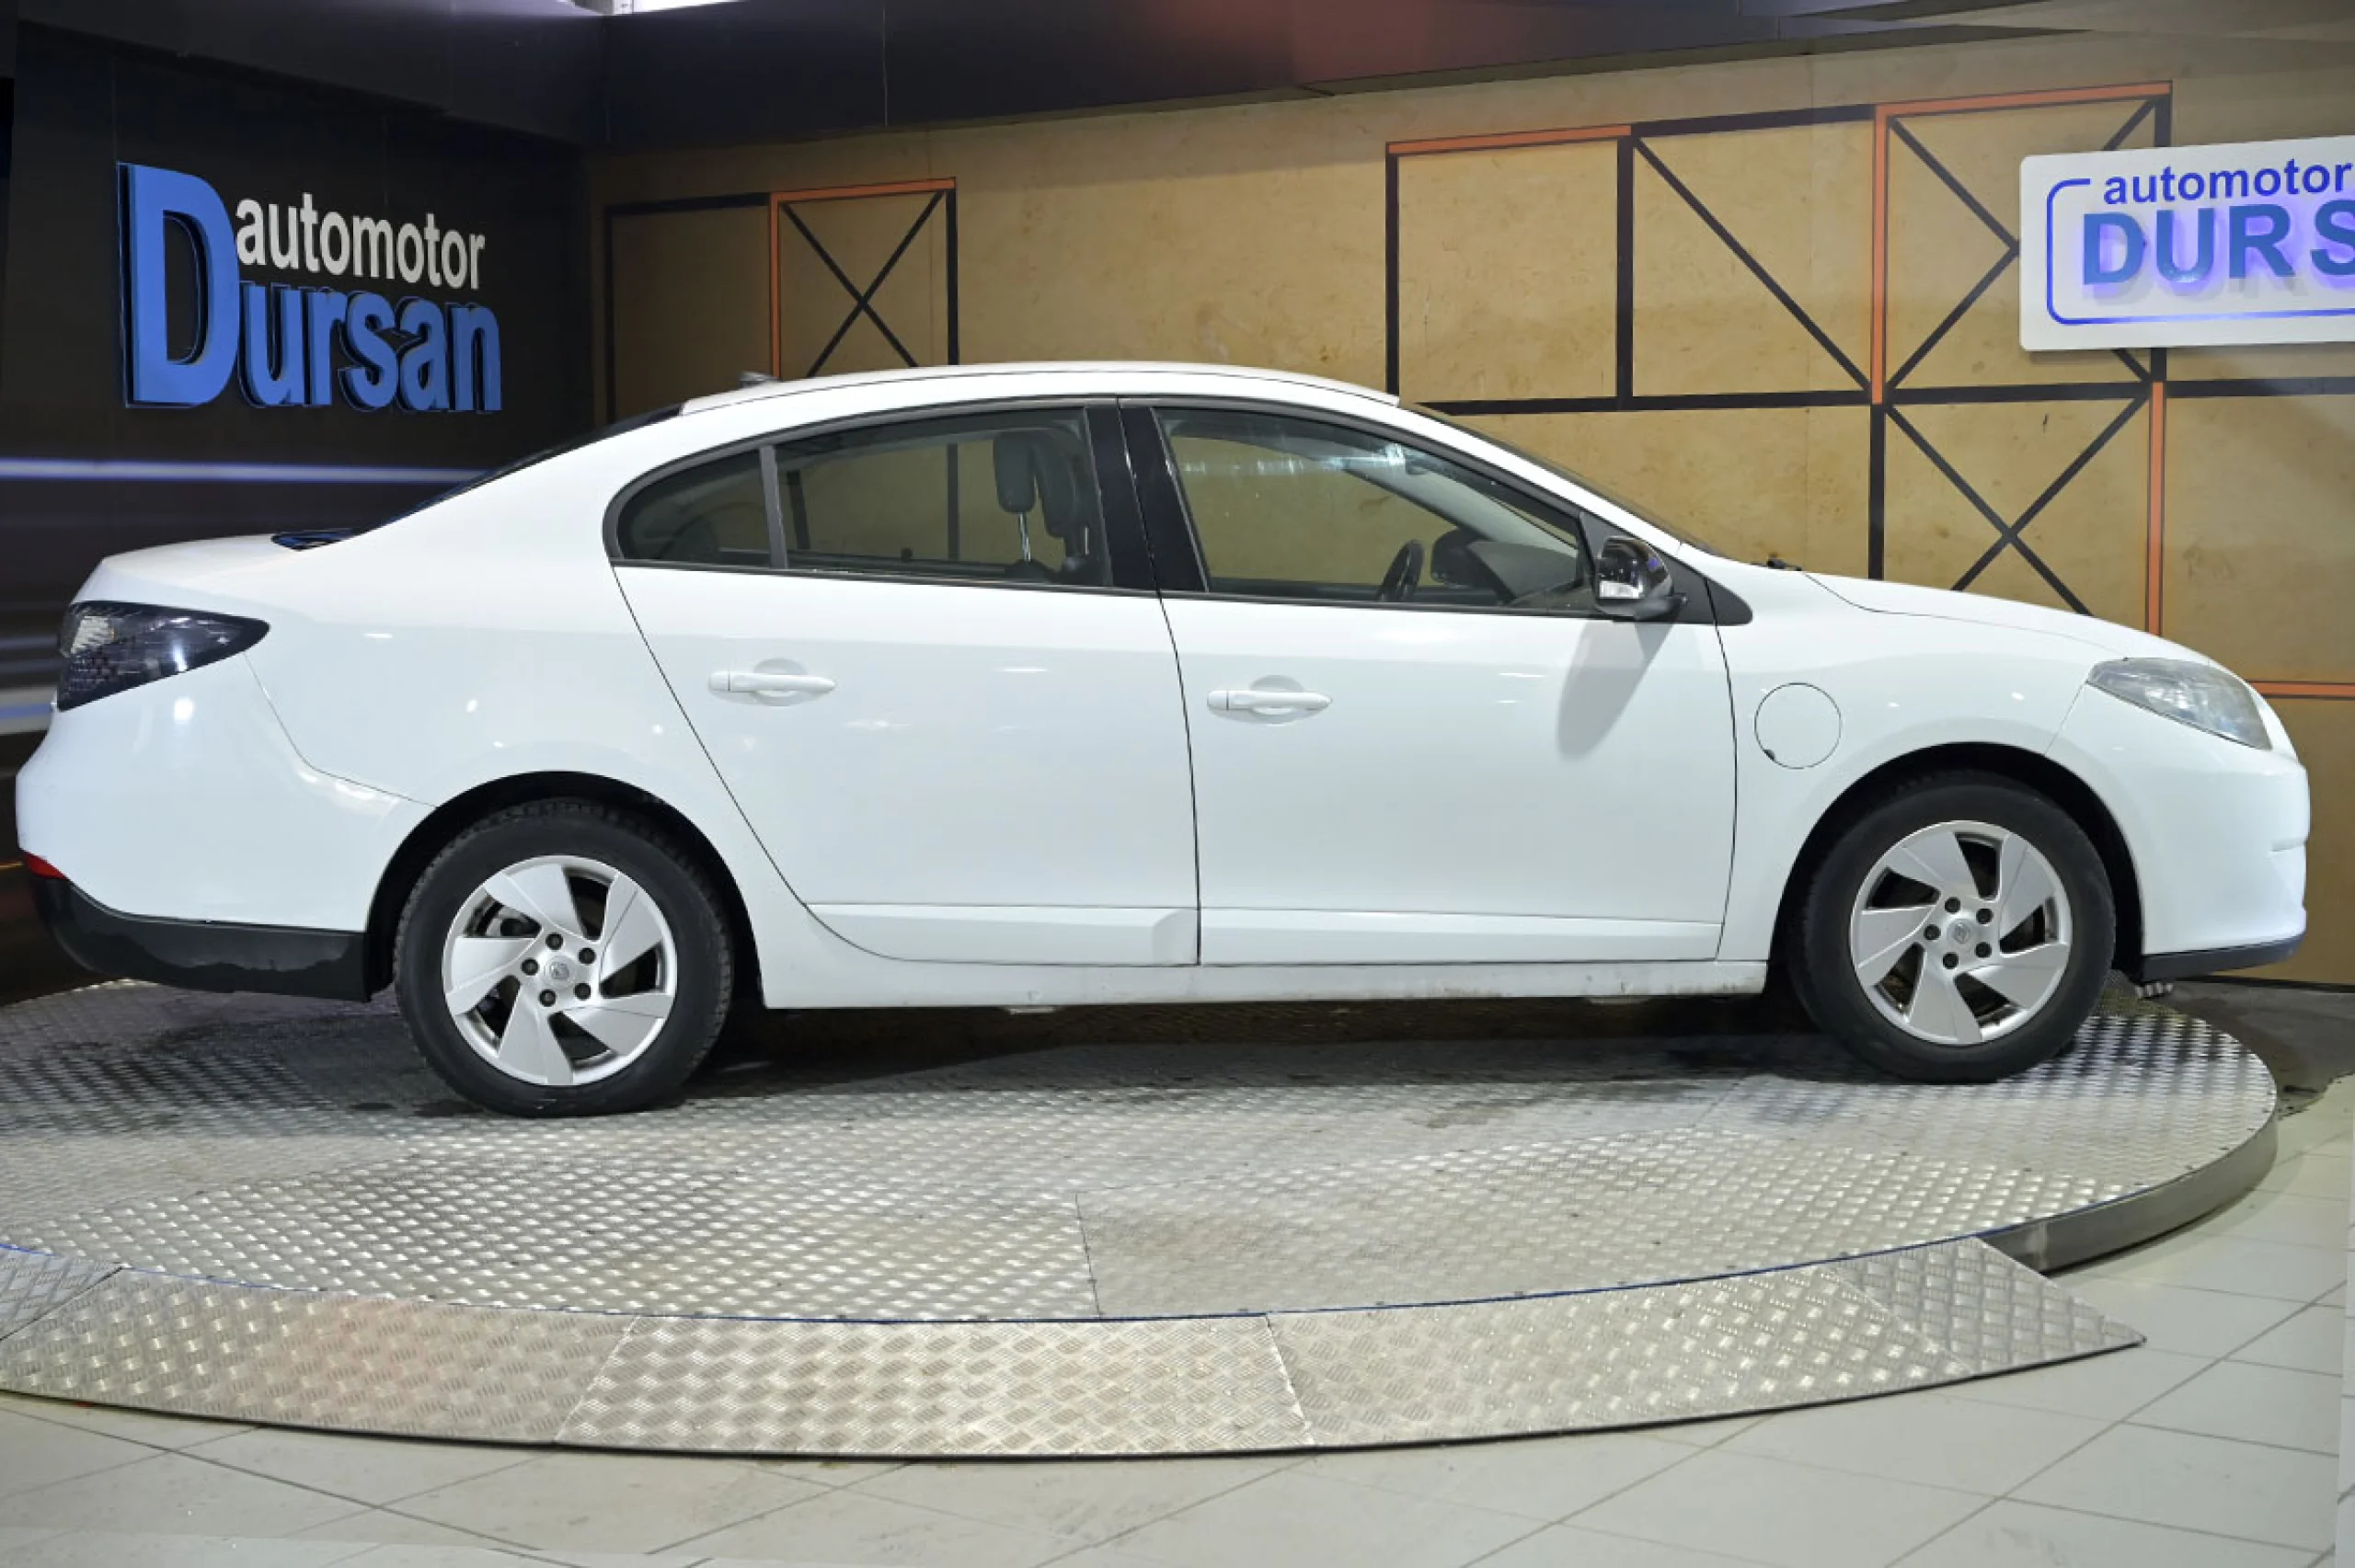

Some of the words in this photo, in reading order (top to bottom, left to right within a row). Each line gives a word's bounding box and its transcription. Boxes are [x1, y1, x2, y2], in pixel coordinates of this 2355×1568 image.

[2103, 158, 2353, 205] automotor
[117, 161, 502, 414] Dursan
[236, 191, 486, 291] automotor
